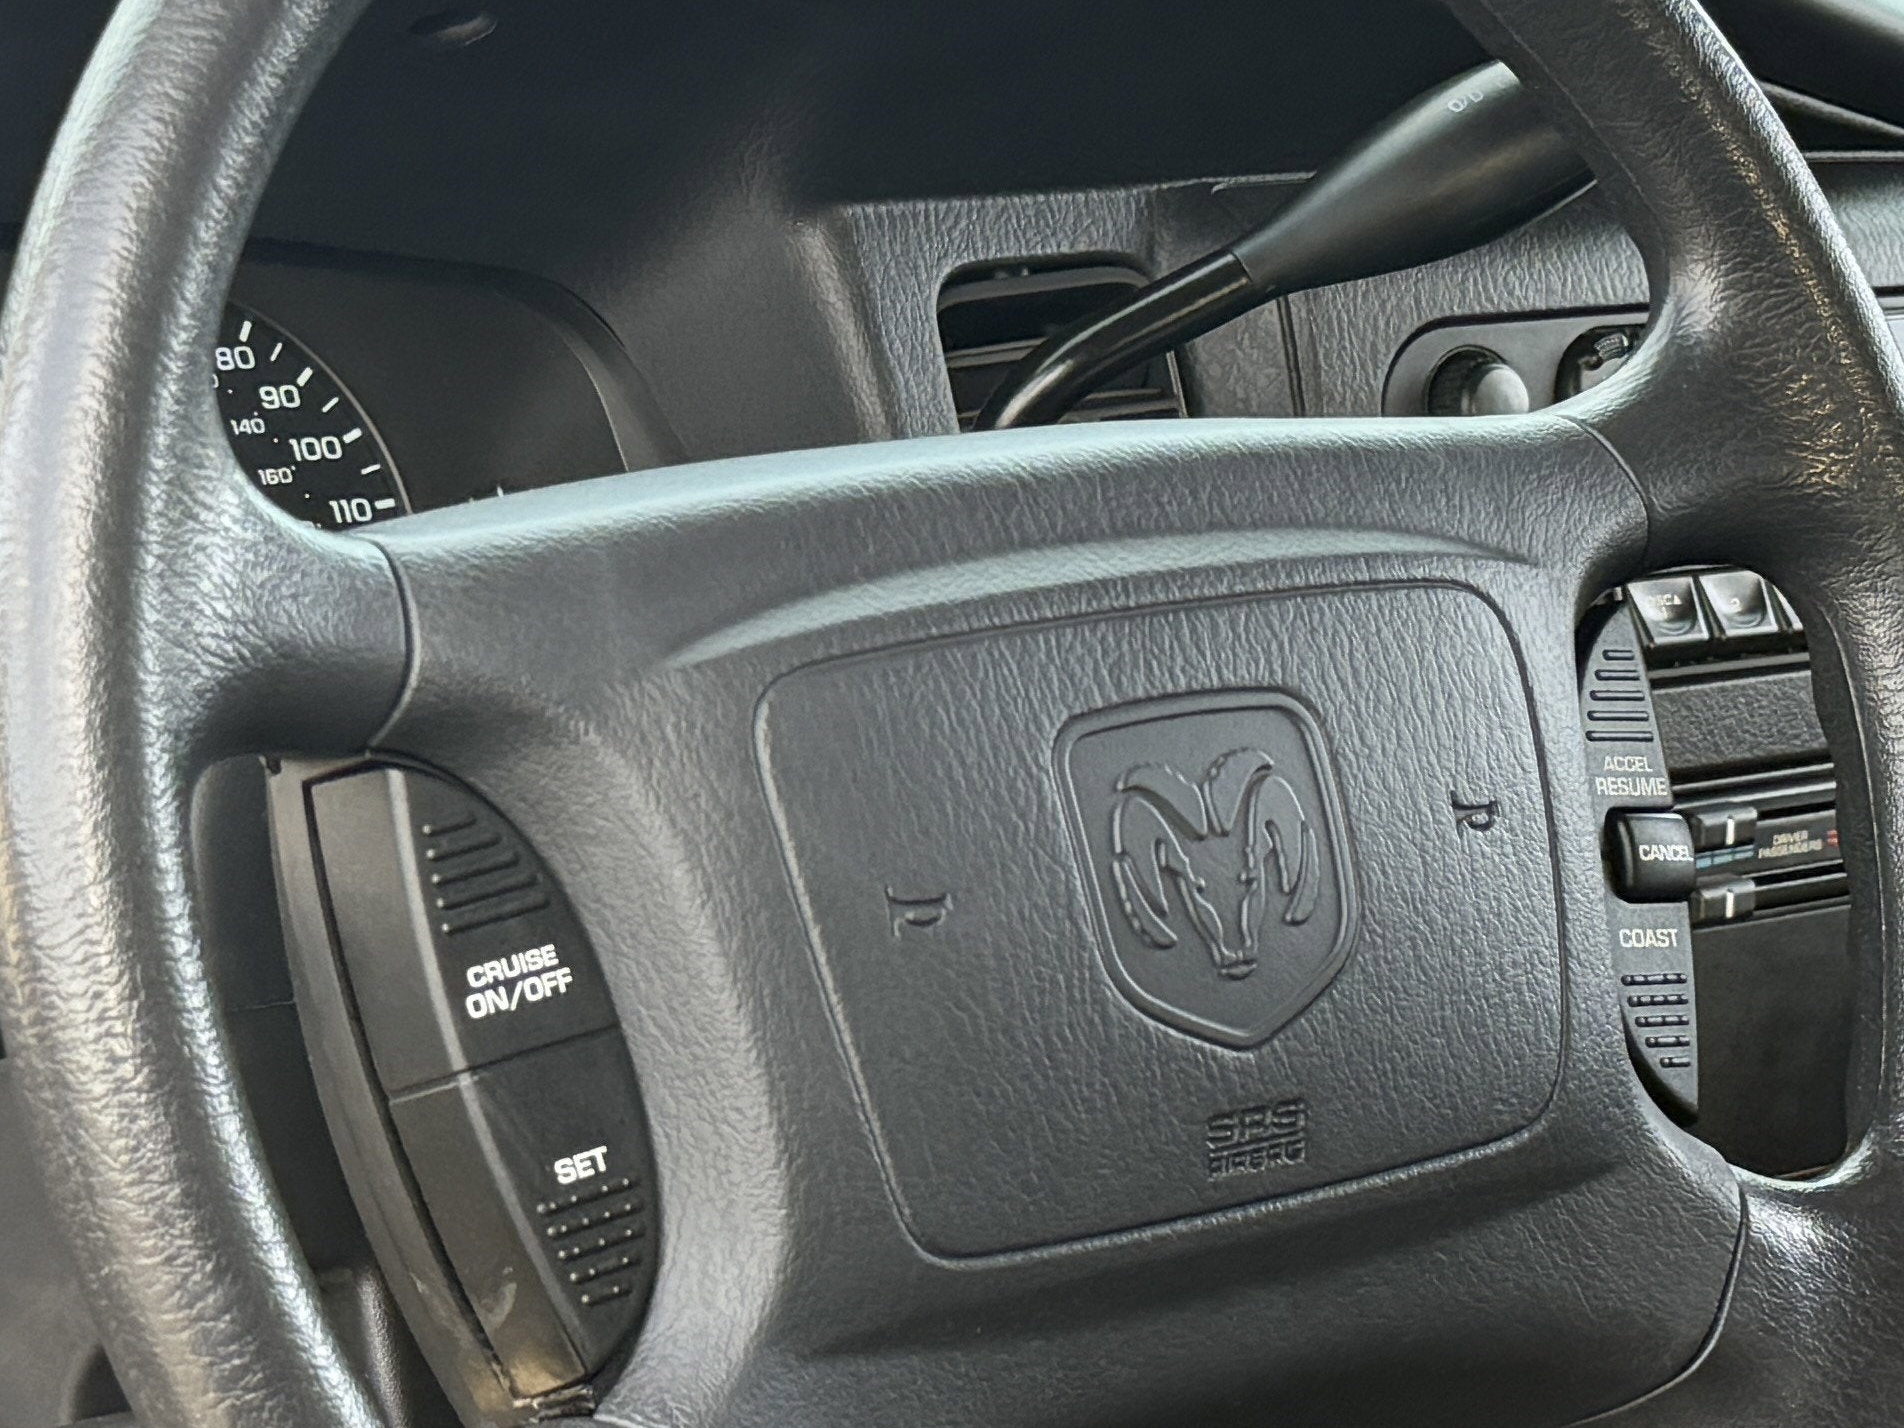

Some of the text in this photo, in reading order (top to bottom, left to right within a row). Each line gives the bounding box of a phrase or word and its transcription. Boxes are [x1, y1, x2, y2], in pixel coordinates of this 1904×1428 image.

[215, 345, 256, 372] 80
[258, 385, 301, 411] 90
[231, 418, 267, 436] 140
[288, 435, 344, 463] 100
[258, 467, 293, 486] 160
[328, 497, 374, 524] 110
[1603, 755, 1653, 774] ACCEL
[1596, 776, 1668, 798] RESUME
[1638, 842, 1691, 864] CANCEL
[1618, 926, 1678, 950] COAST
[465, 943, 559, 991] CRUISE
[464, 966, 574, 1020] ON/OFF
[553, 1144, 608, 1186] SET
